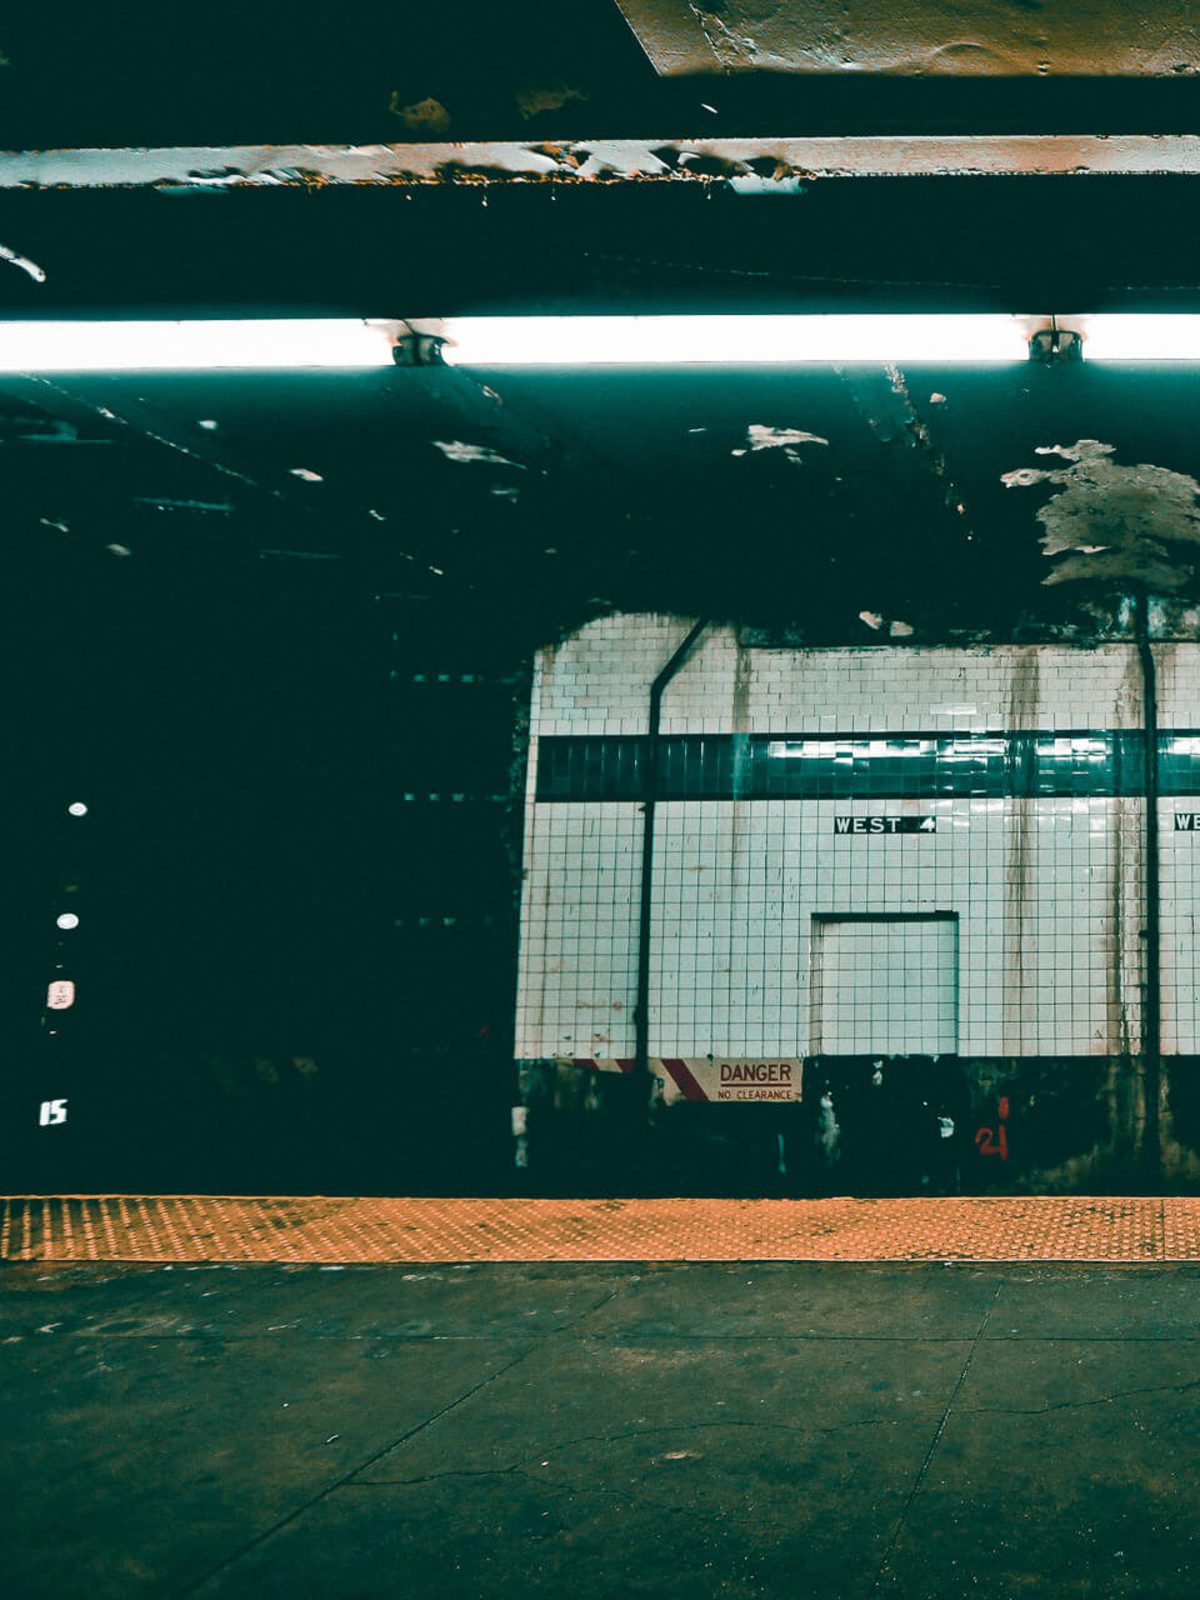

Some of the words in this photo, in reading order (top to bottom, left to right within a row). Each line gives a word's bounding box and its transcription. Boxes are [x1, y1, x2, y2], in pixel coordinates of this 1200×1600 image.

[836, 818, 901, 833] WEST
[919, 816, 936, 833] 4
[720, 1064, 792, 1082] DANGER
[718, 1090, 732, 1100] NO
[737, 1089, 793, 1100] CLEARANCE
[39, 1098, 69, 1126] 15
